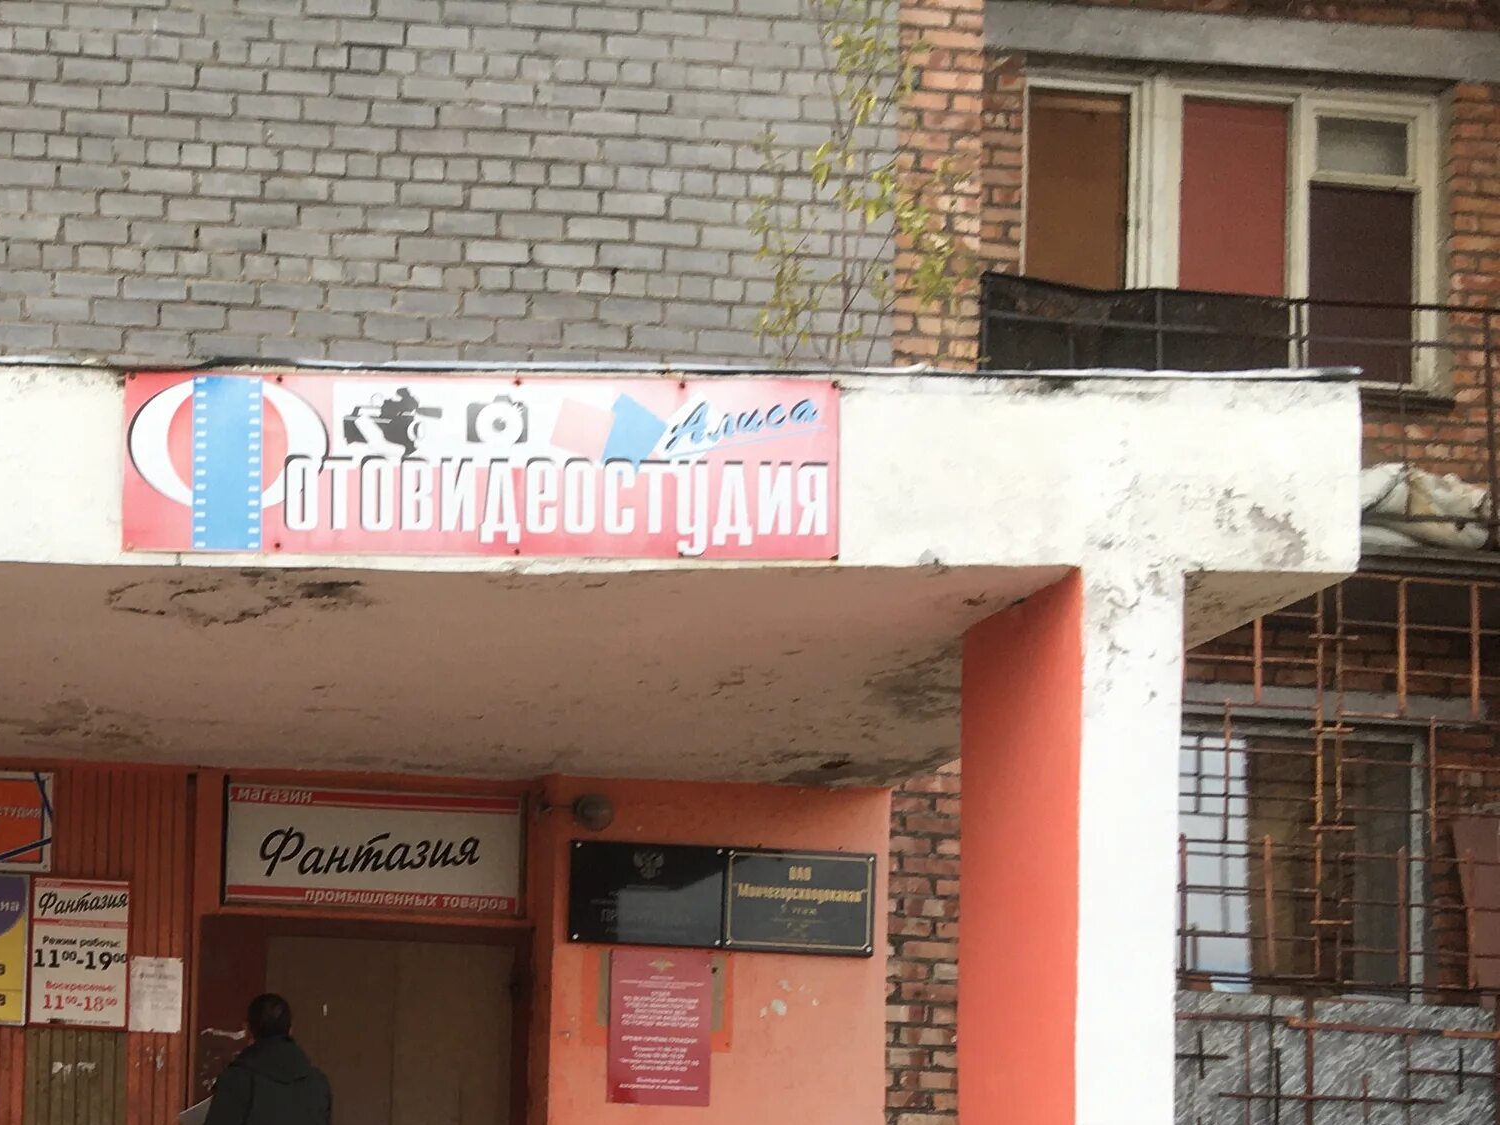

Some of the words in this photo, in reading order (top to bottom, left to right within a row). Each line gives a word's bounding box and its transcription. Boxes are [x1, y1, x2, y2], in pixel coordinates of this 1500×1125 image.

[666, 395, 819, 452] Алиса
[237, 786, 313, 805] магазин
[259, 826, 481, 877] Фантазия
[38, 890, 130, 918] Фантазия
[304, 887, 437, 908] промышленных
[439, 895, 509, 911] товаров
[42, 935, 77, 948] Режим
